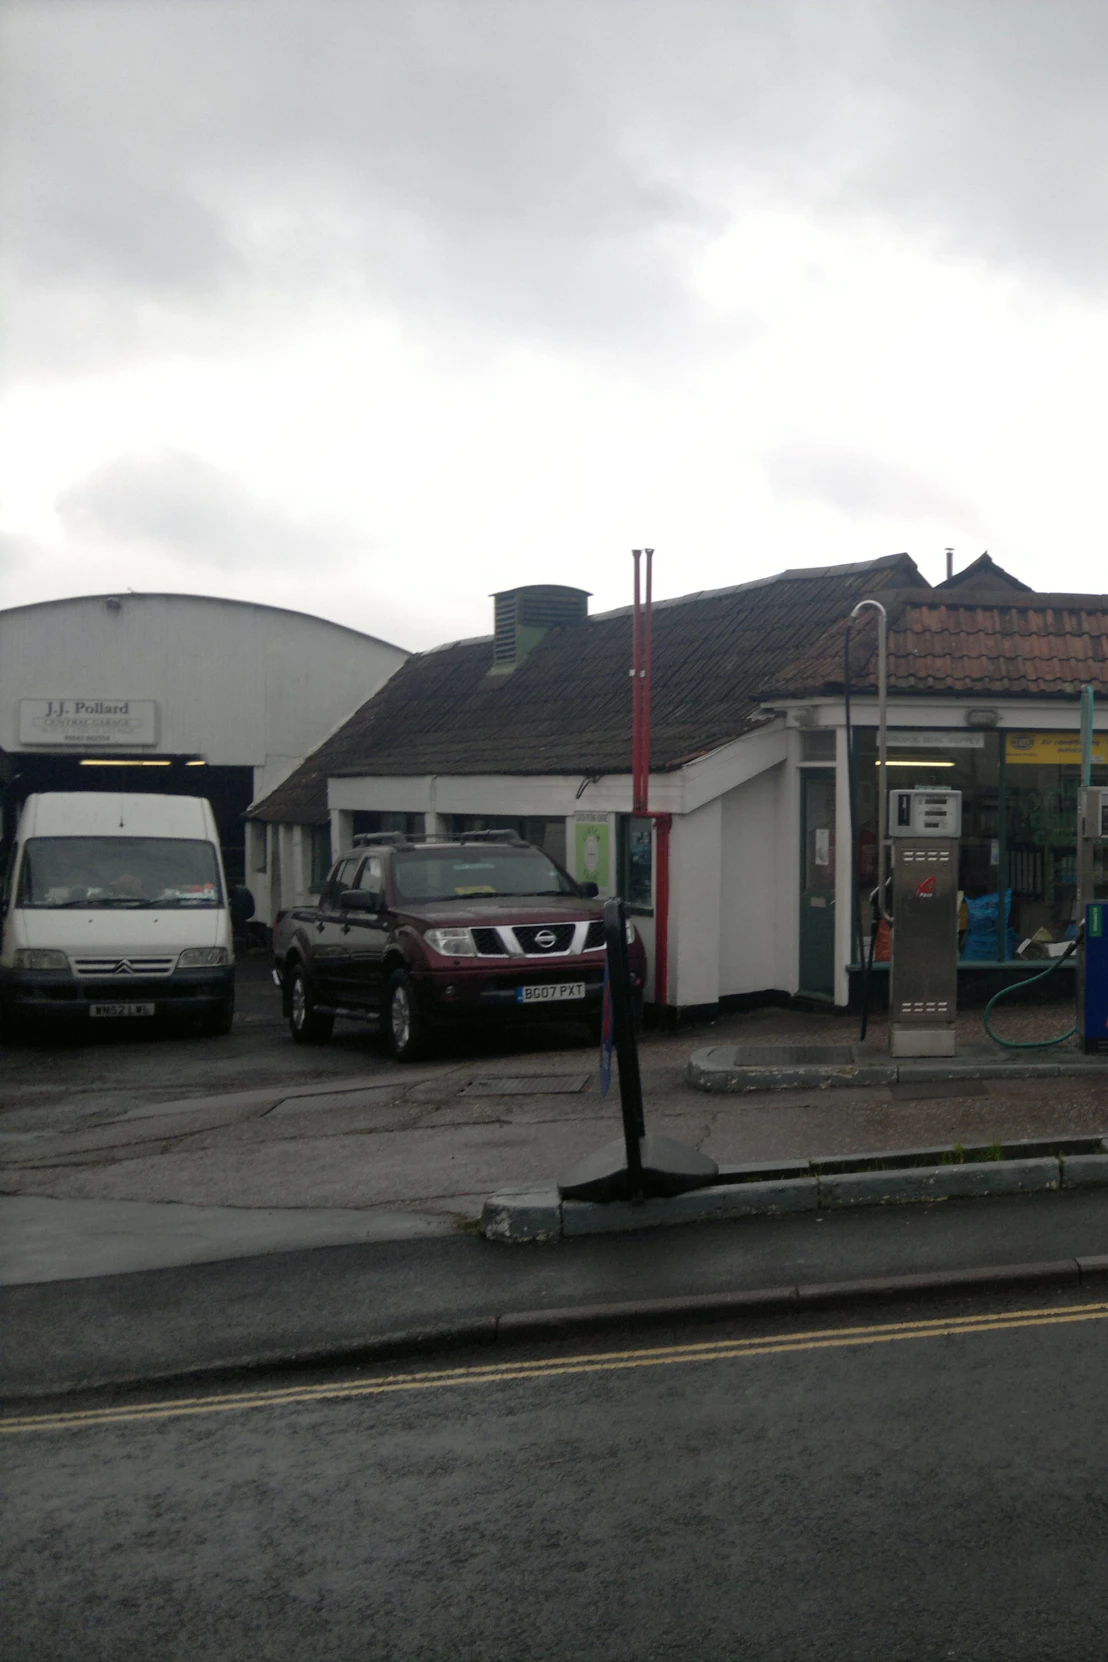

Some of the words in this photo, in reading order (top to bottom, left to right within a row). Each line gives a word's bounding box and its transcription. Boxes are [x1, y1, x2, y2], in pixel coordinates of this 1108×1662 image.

[45, 701, 69, 717] J.J.
[74, 702, 130, 715] Pollard
[525, 986, 557, 999] BG07
[559, 984, 583, 997] PXT
